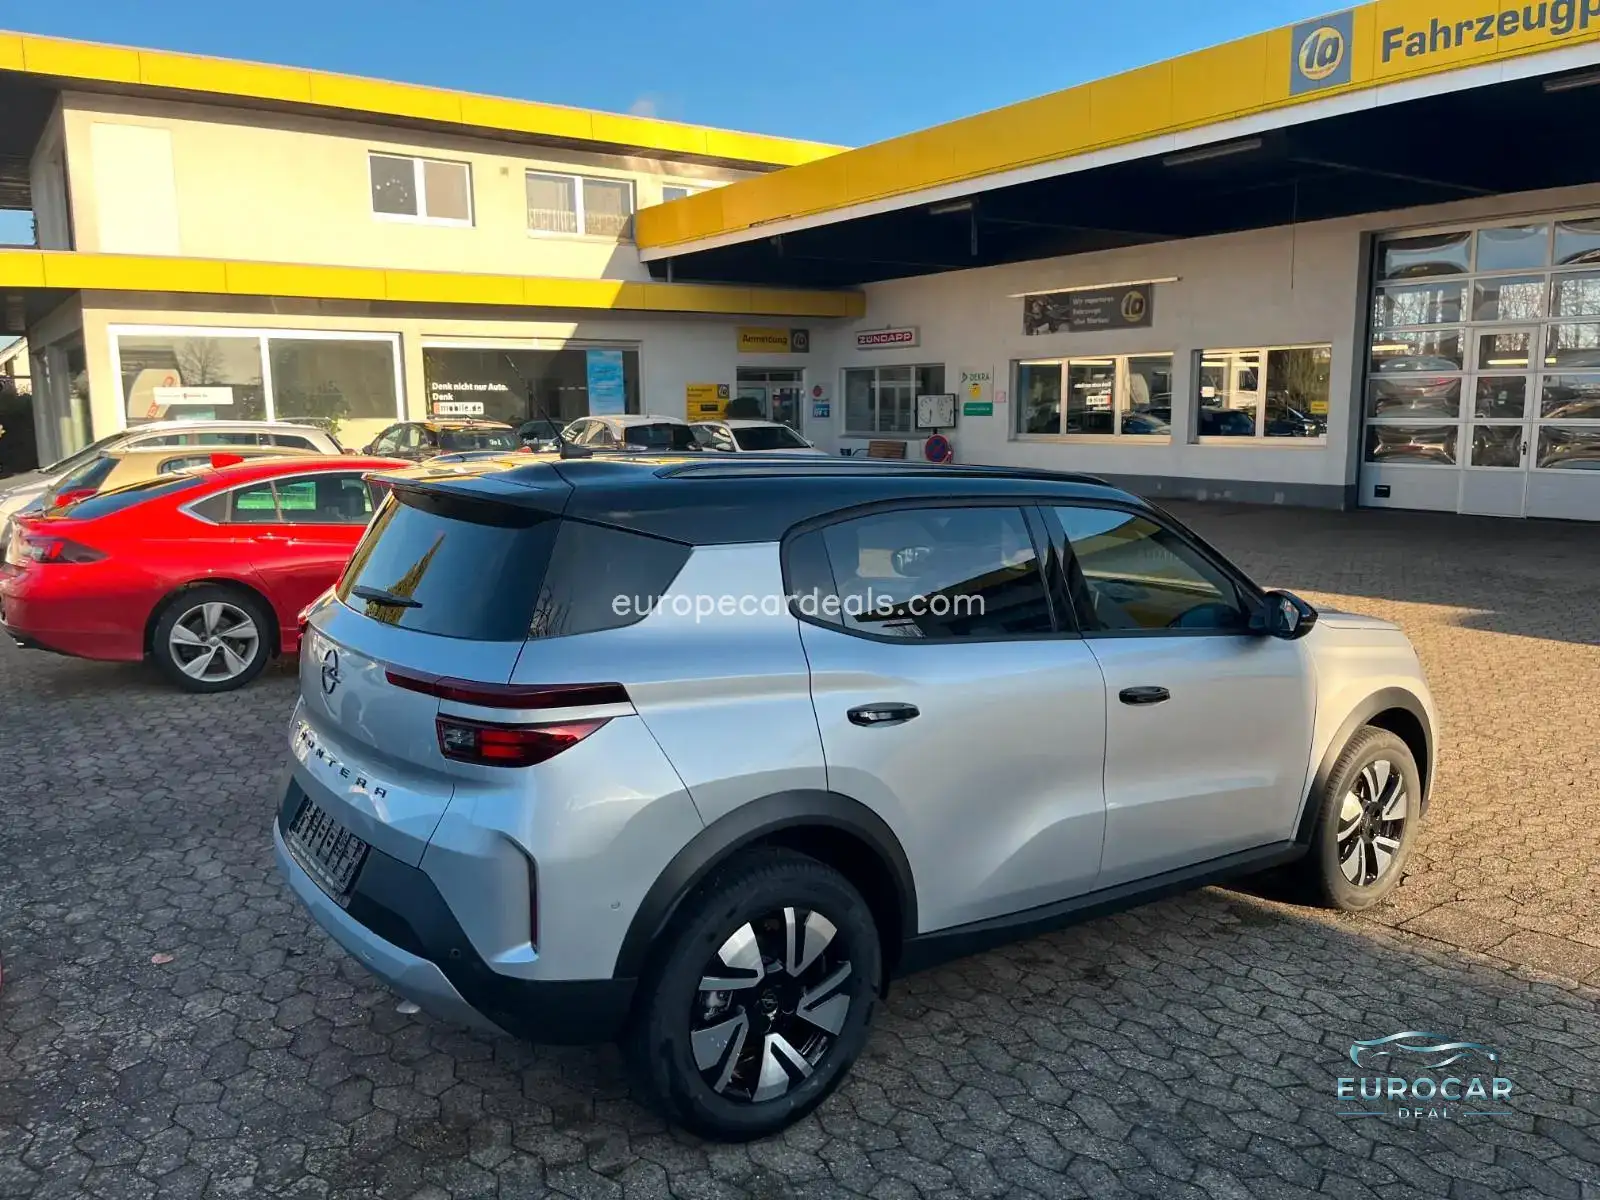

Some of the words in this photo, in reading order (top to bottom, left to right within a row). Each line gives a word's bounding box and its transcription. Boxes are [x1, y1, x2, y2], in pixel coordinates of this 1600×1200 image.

[432, 382, 453, 391] Denk
[453, 382, 473, 391] nicht
[432, 393, 454, 401] Denk
